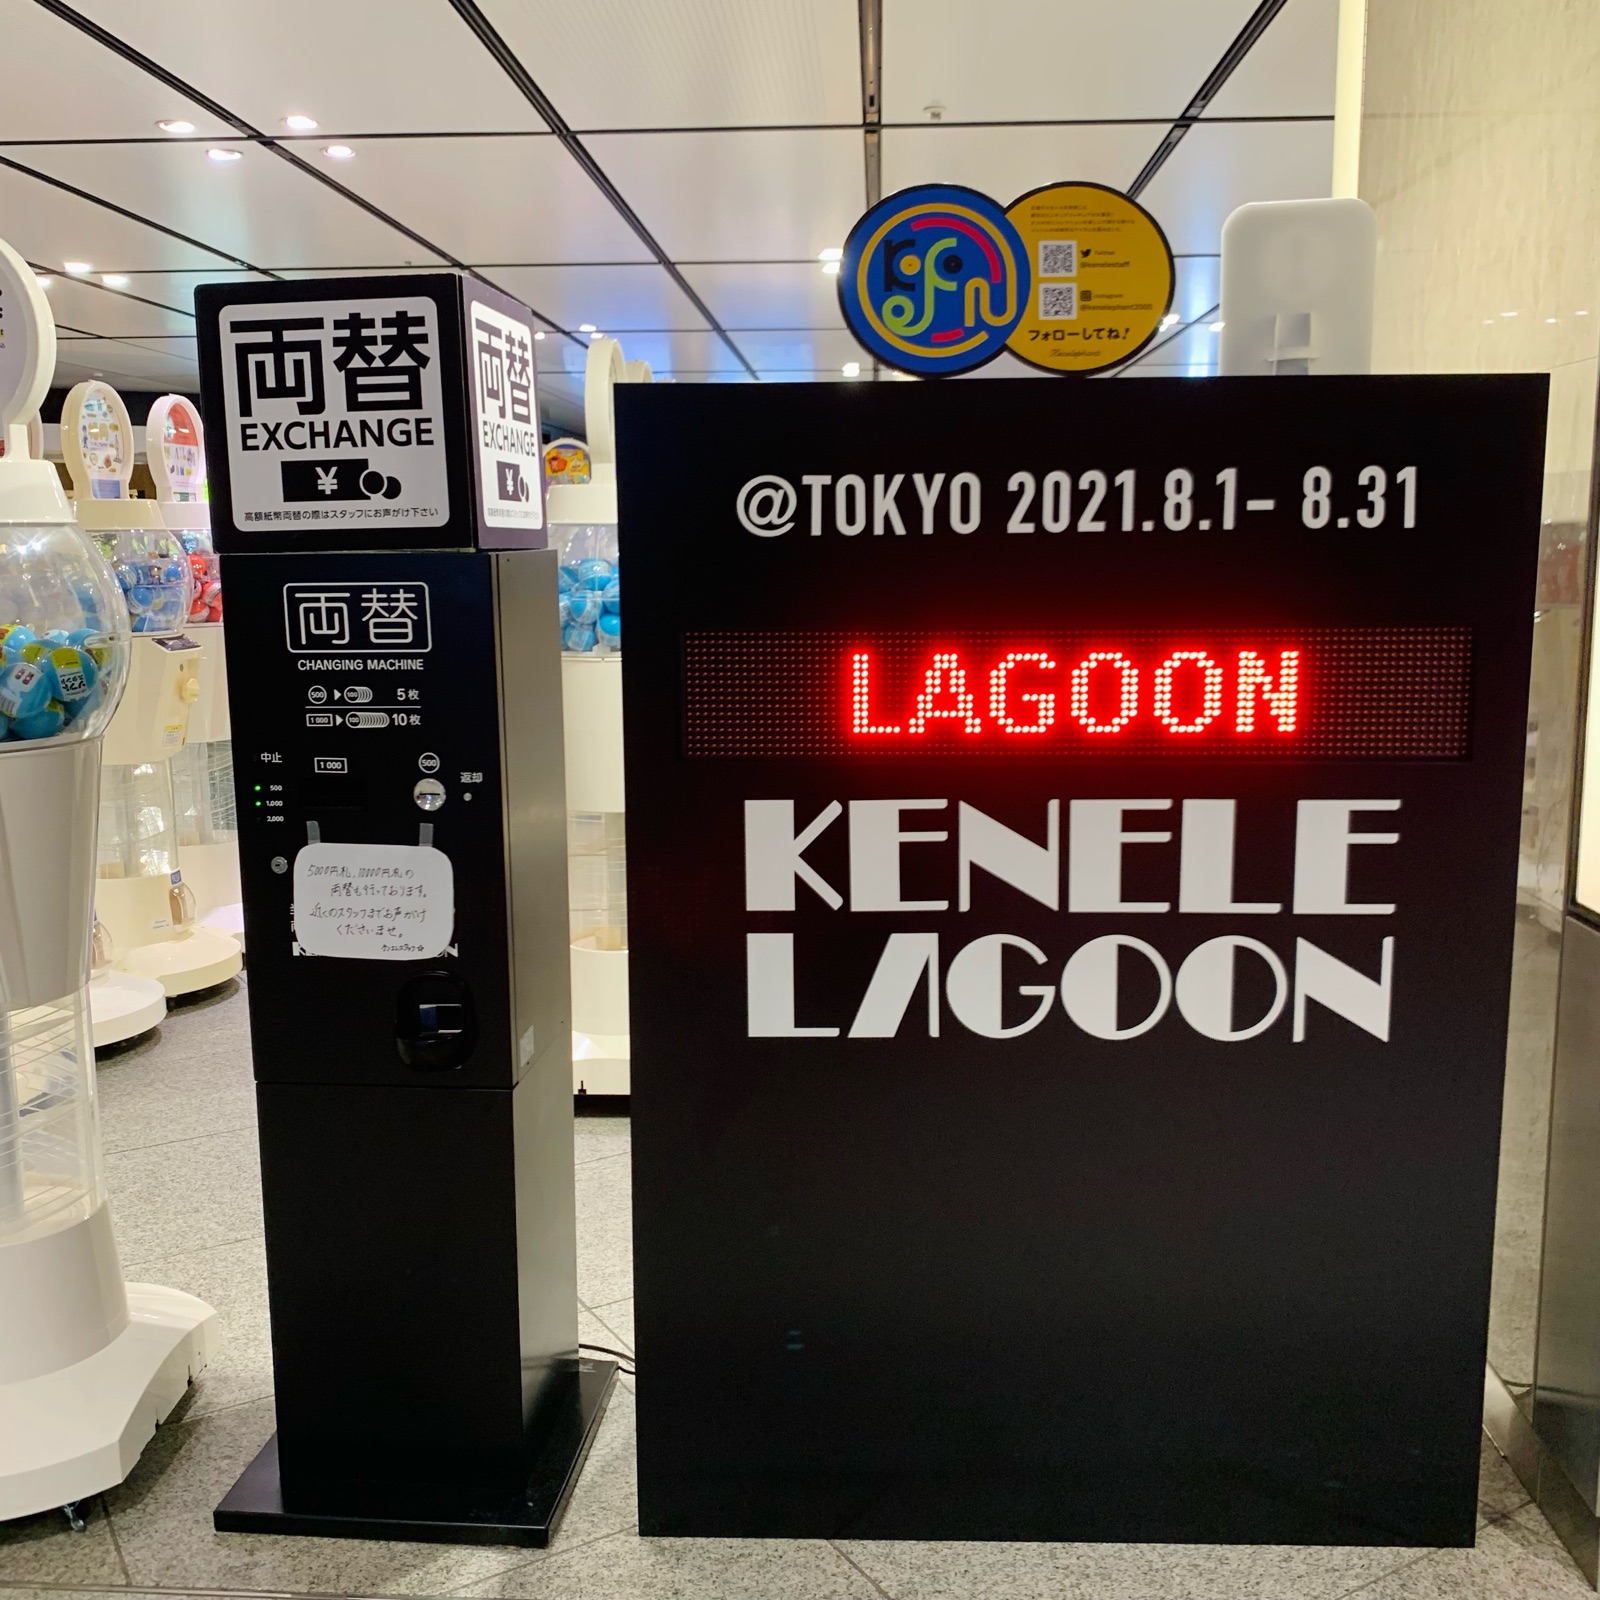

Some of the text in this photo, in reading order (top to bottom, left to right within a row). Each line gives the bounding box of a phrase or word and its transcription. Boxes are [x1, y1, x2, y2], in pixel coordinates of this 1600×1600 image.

[229, 310, 431, 417] 両替
[475, 316, 532, 426] 両替
[241, 417, 434, 452] EXCHANGE
[482, 420, 536, 457] EXCHANGE
[735, 472, 982, 538] @TOKYO
[1301, 464, 1420, 530] 8.31
[244, 507, 439, 522] 高額紙幣両替の際はスタッフにお声がけ下さい
[294, 588, 419, 645] 両替
[297, 658, 425, 671] CHANGING MACHINE
[310, 691, 325, 699] 500
[851, 649, 1302, 735] LAGOON
[260, 751, 283, 763] 中止
[421, 759, 437, 767] 500
[460, 771, 483, 783] 返却
[269, 784, 283, 792] 500
[744, 797, 1402, 915] KENELE
[330, 881, 428, 898] 両替も行っております。
[309, 902, 428, 922] 近くのスタッフまでお声がけ
[335, 923, 403, 938] くださいませ。
[745, 932, 1395, 1043] LAGOON
